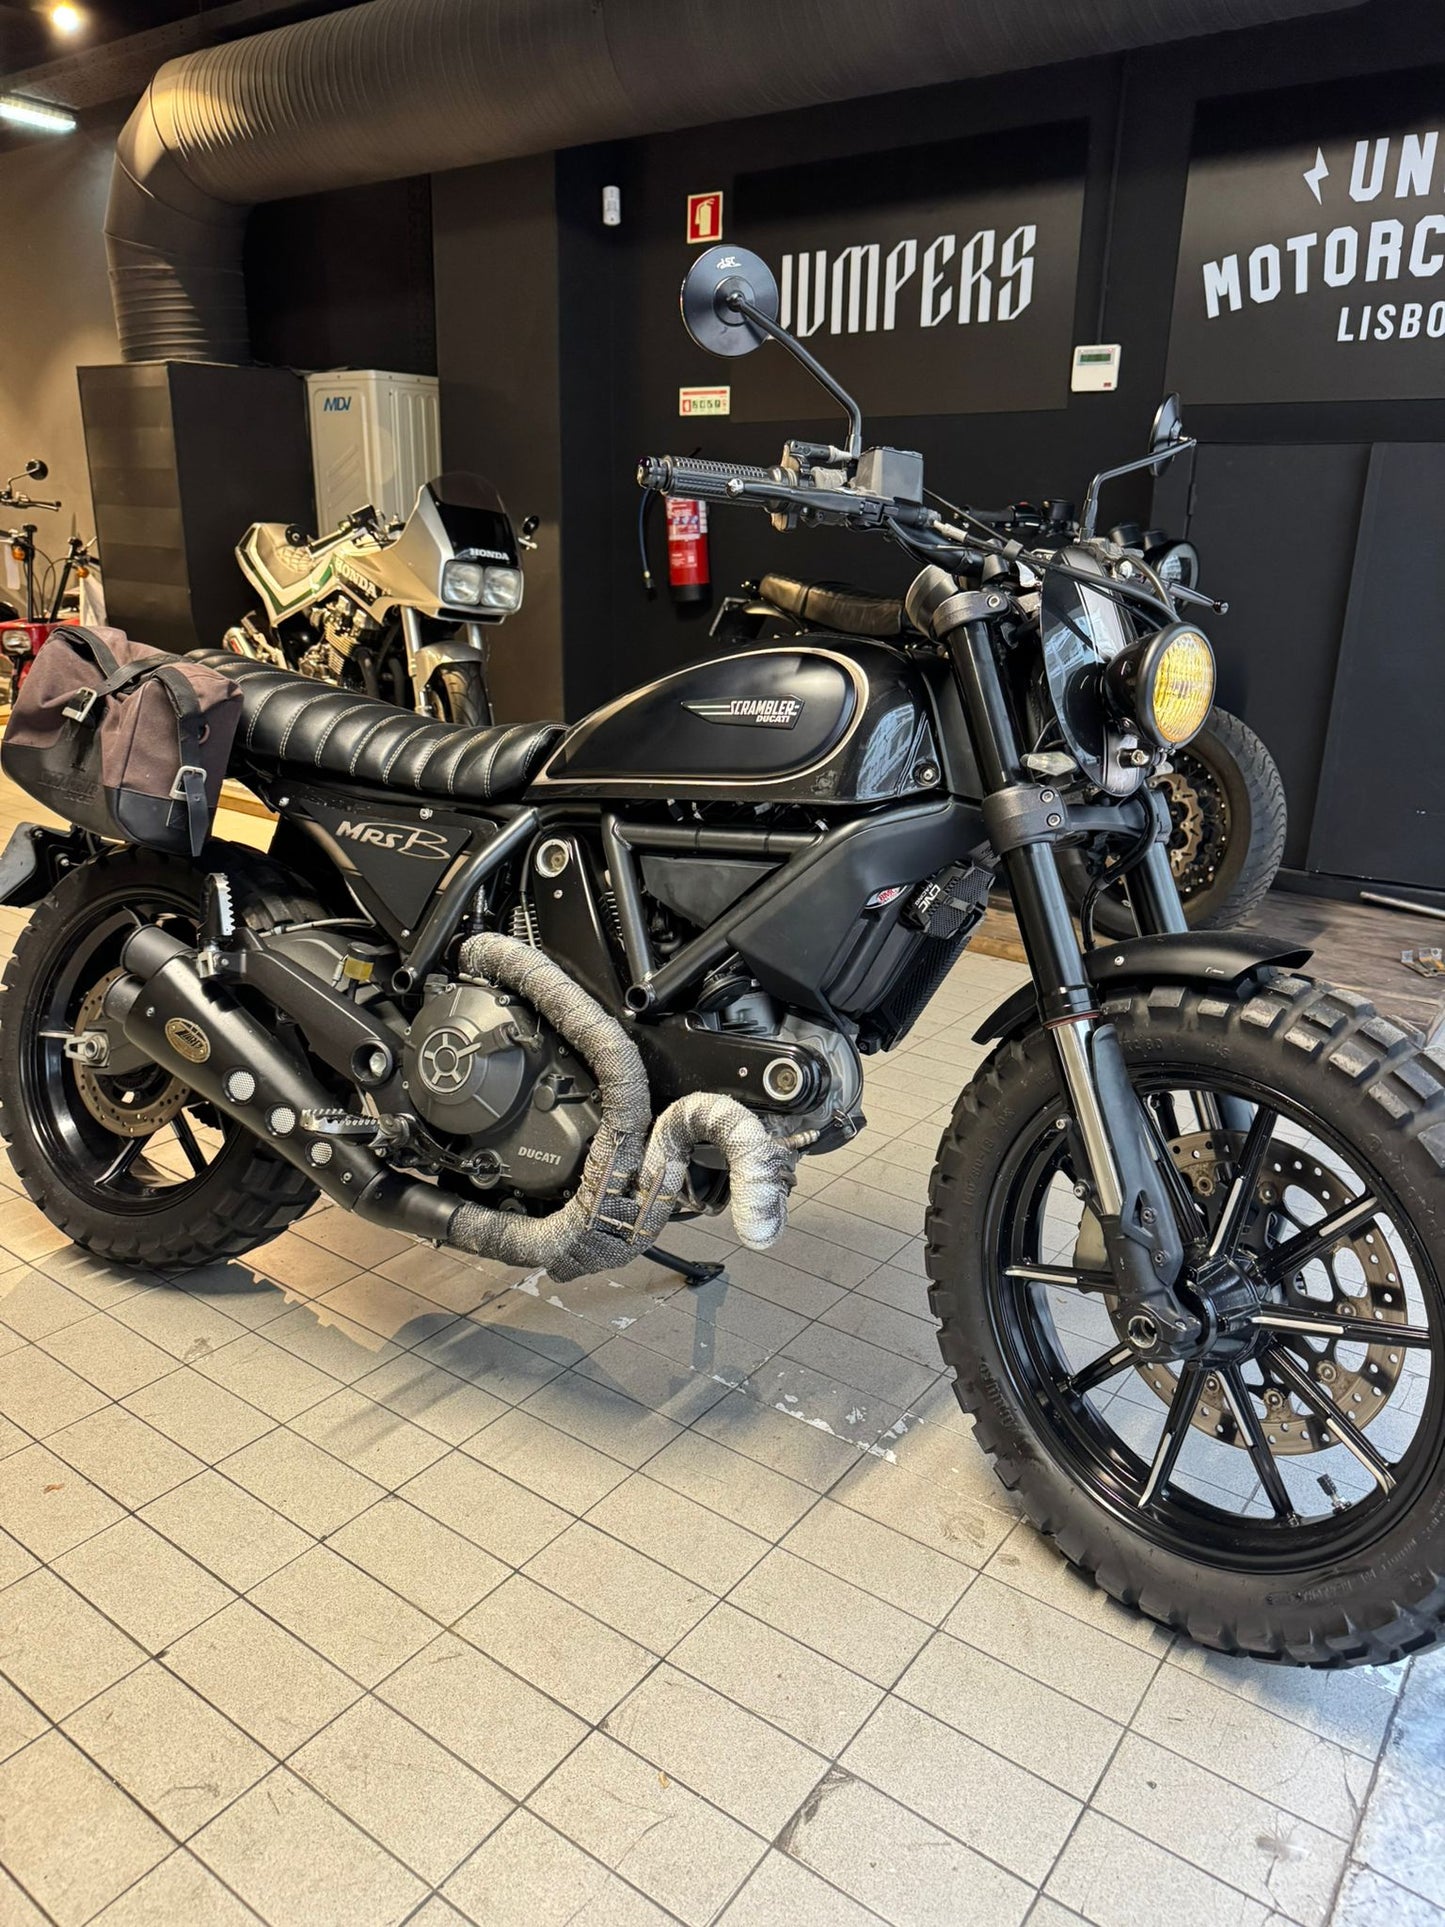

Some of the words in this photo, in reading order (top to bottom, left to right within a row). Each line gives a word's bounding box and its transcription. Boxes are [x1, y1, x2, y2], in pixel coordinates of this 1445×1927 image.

[1349, 131, 1445, 202] UN
[469, 547, 510, 561] HONDA
[335, 556, 378, 599] HONDA
[730, 700, 797, 716] SCRAMBLER
[755, 714, 790, 723] DUCATI
[917, 883, 941, 914] CNC
[517, 1145, 562, 1166] DUCATI
